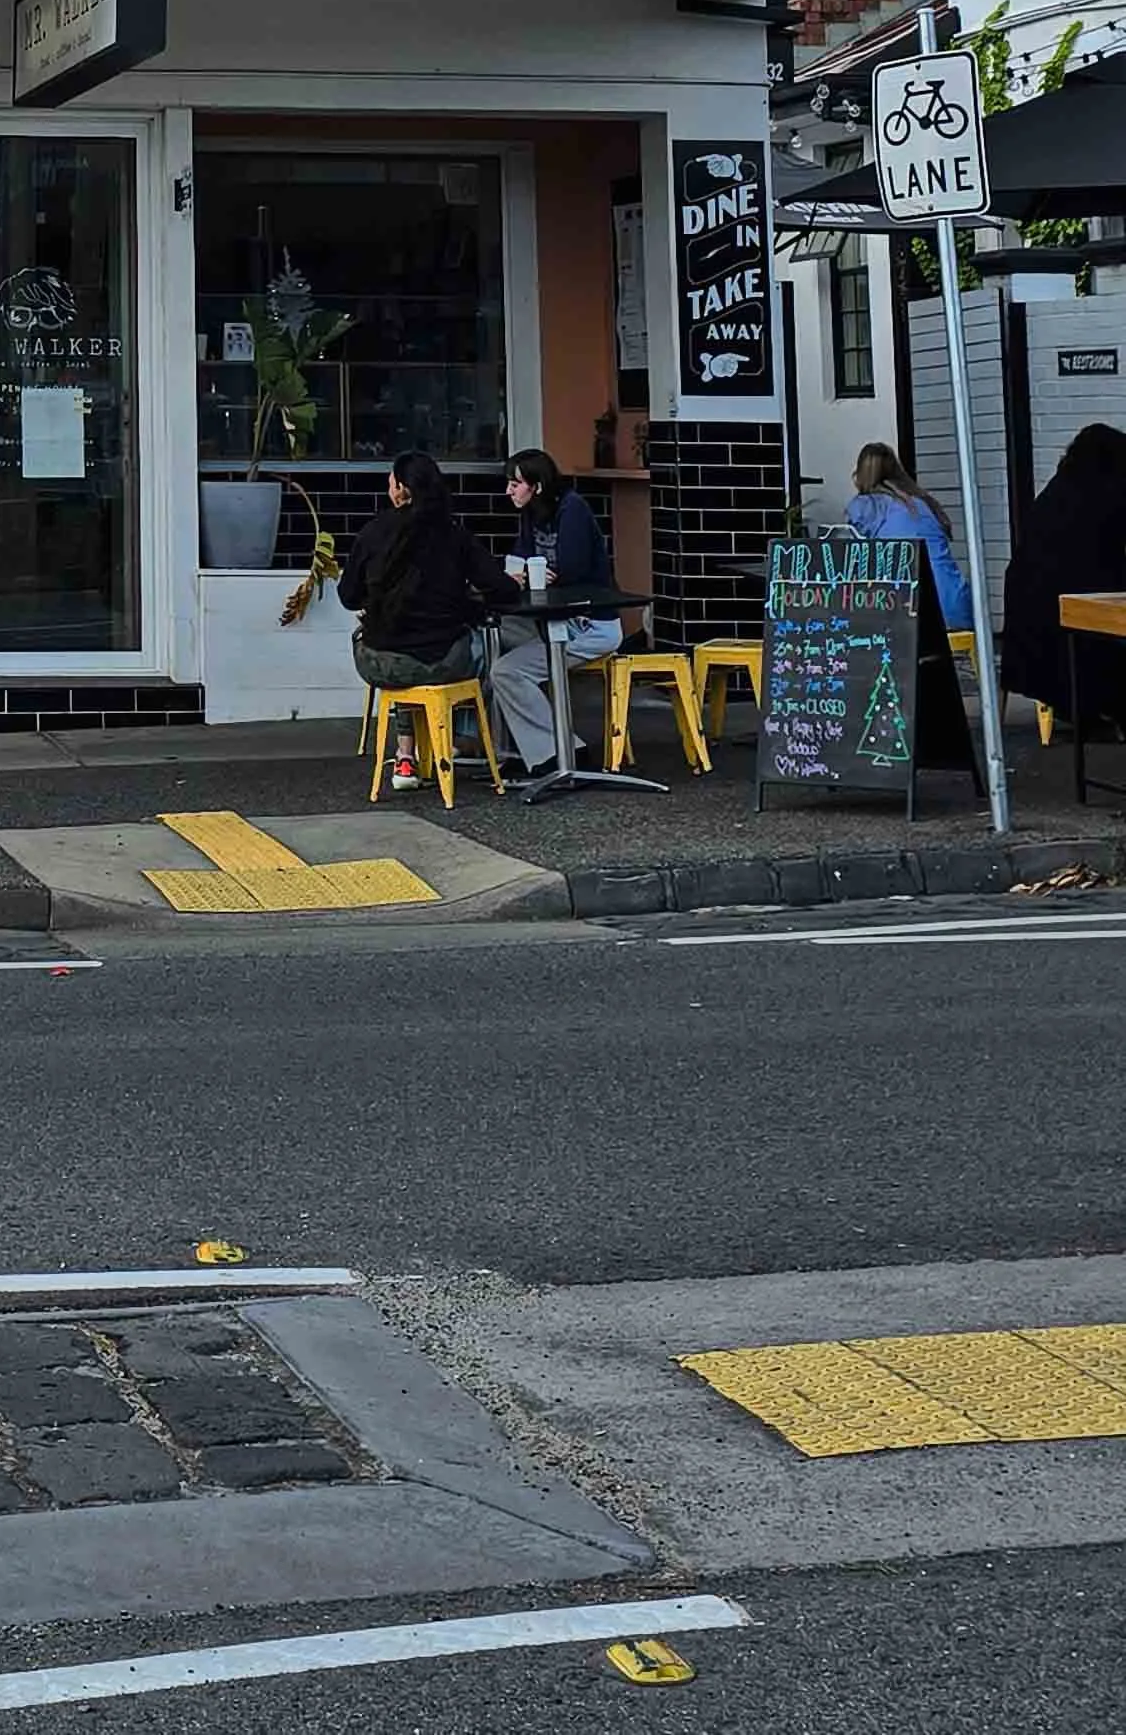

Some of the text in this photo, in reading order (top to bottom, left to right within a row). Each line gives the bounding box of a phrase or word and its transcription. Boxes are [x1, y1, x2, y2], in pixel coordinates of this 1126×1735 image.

[767, 63, 784, 81] 32
[887, 156, 974, 200] LANE
[682, 183, 759, 235] DINE
[736, 224, 761, 247] IN
[687, 268, 764, 320] TAKE
[706, 324, 763, 341] AWAY
[14, 338, 122, 356] WALKER
[773, 544, 821, 582] MR.
[842, 583, 896, 612] HOURS
[806, 698, 846, 716] CLOSED
